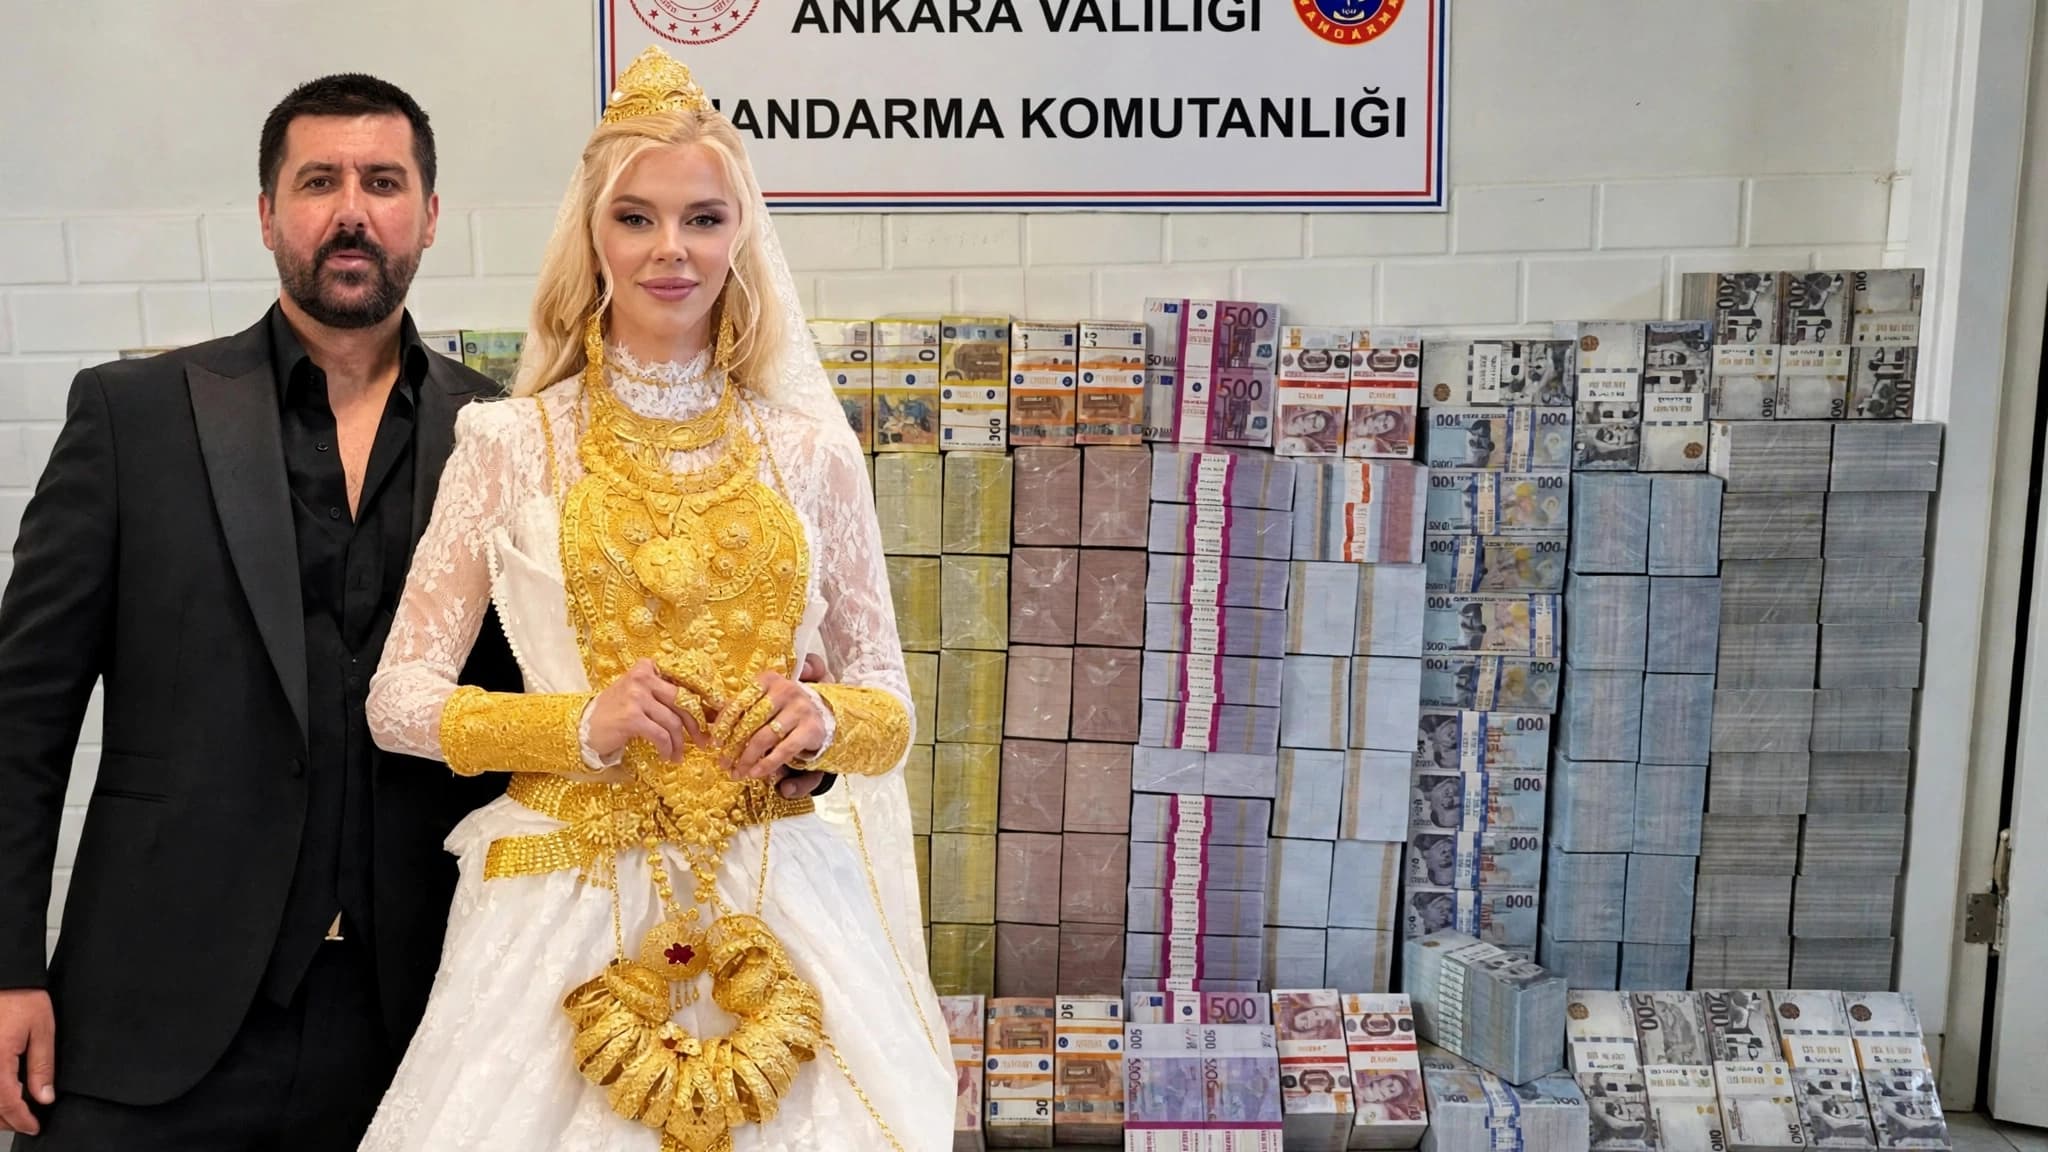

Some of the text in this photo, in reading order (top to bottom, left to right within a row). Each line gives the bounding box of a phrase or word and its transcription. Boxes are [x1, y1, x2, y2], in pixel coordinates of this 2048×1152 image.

[791, 0, 1023, 33] ANKARA
[1021, 86, 1406, 139] KOMUTANLIĞI
[1222, 306, 1268, 328] 500
[1218, 378, 1262, 400] 500
[1210, 997, 1257, 1020] 500
